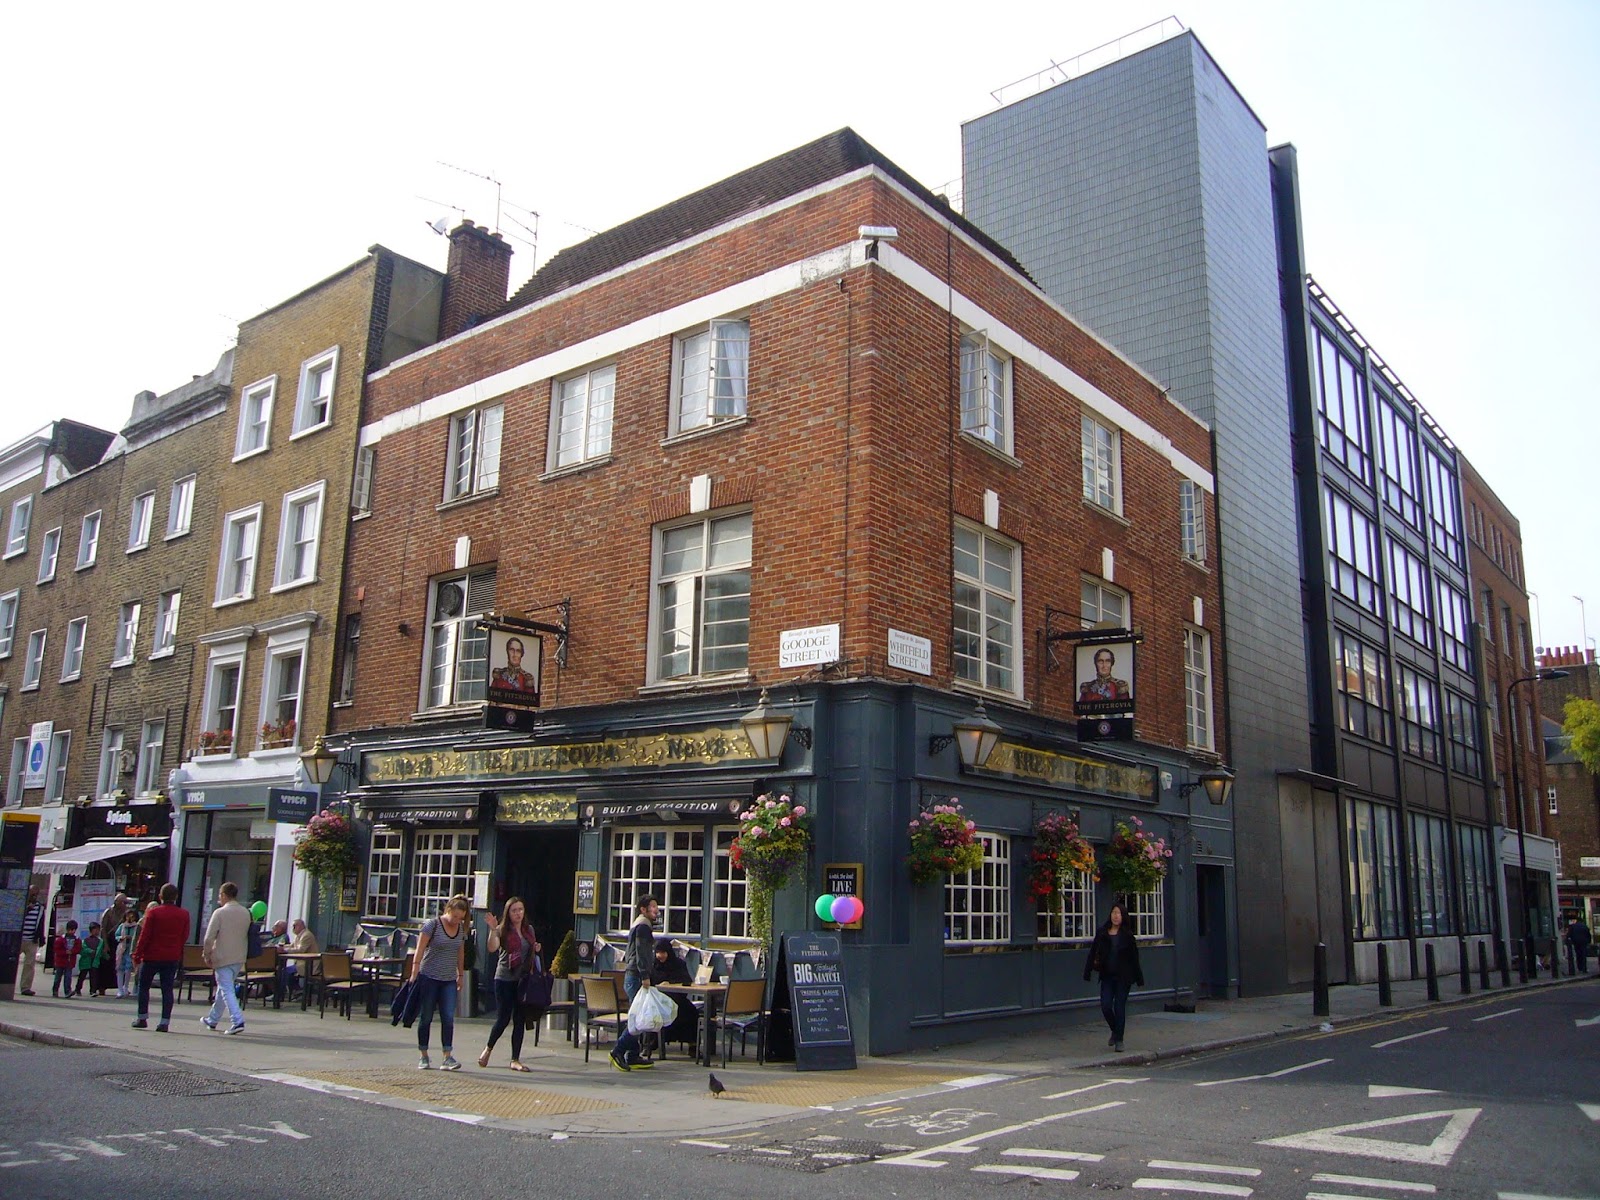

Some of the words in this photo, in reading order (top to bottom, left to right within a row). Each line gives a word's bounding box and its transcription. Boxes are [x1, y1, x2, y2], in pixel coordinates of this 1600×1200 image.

[782, 635, 830, 650] GOODGE
[781, 649, 822, 663] STREET
[824, 649, 837, 658] W1
[889, 640, 929, 660] WHITFIELD
[889, 653, 918, 668] STREET
[920, 663, 929, 672] W1
[280, 795, 307, 805] YMCA
[414, 810, 458, 818] TRADITION
[602, 805, 632, 814] BUILT
[653, 802, 718, 811] TRADITION
[578, 880, 594, 888] LUNCH
[832, 880, 852, 892] LIVE
[793, 963, 813, 983] BIG
[813, 972, 841, 983] MATCH
